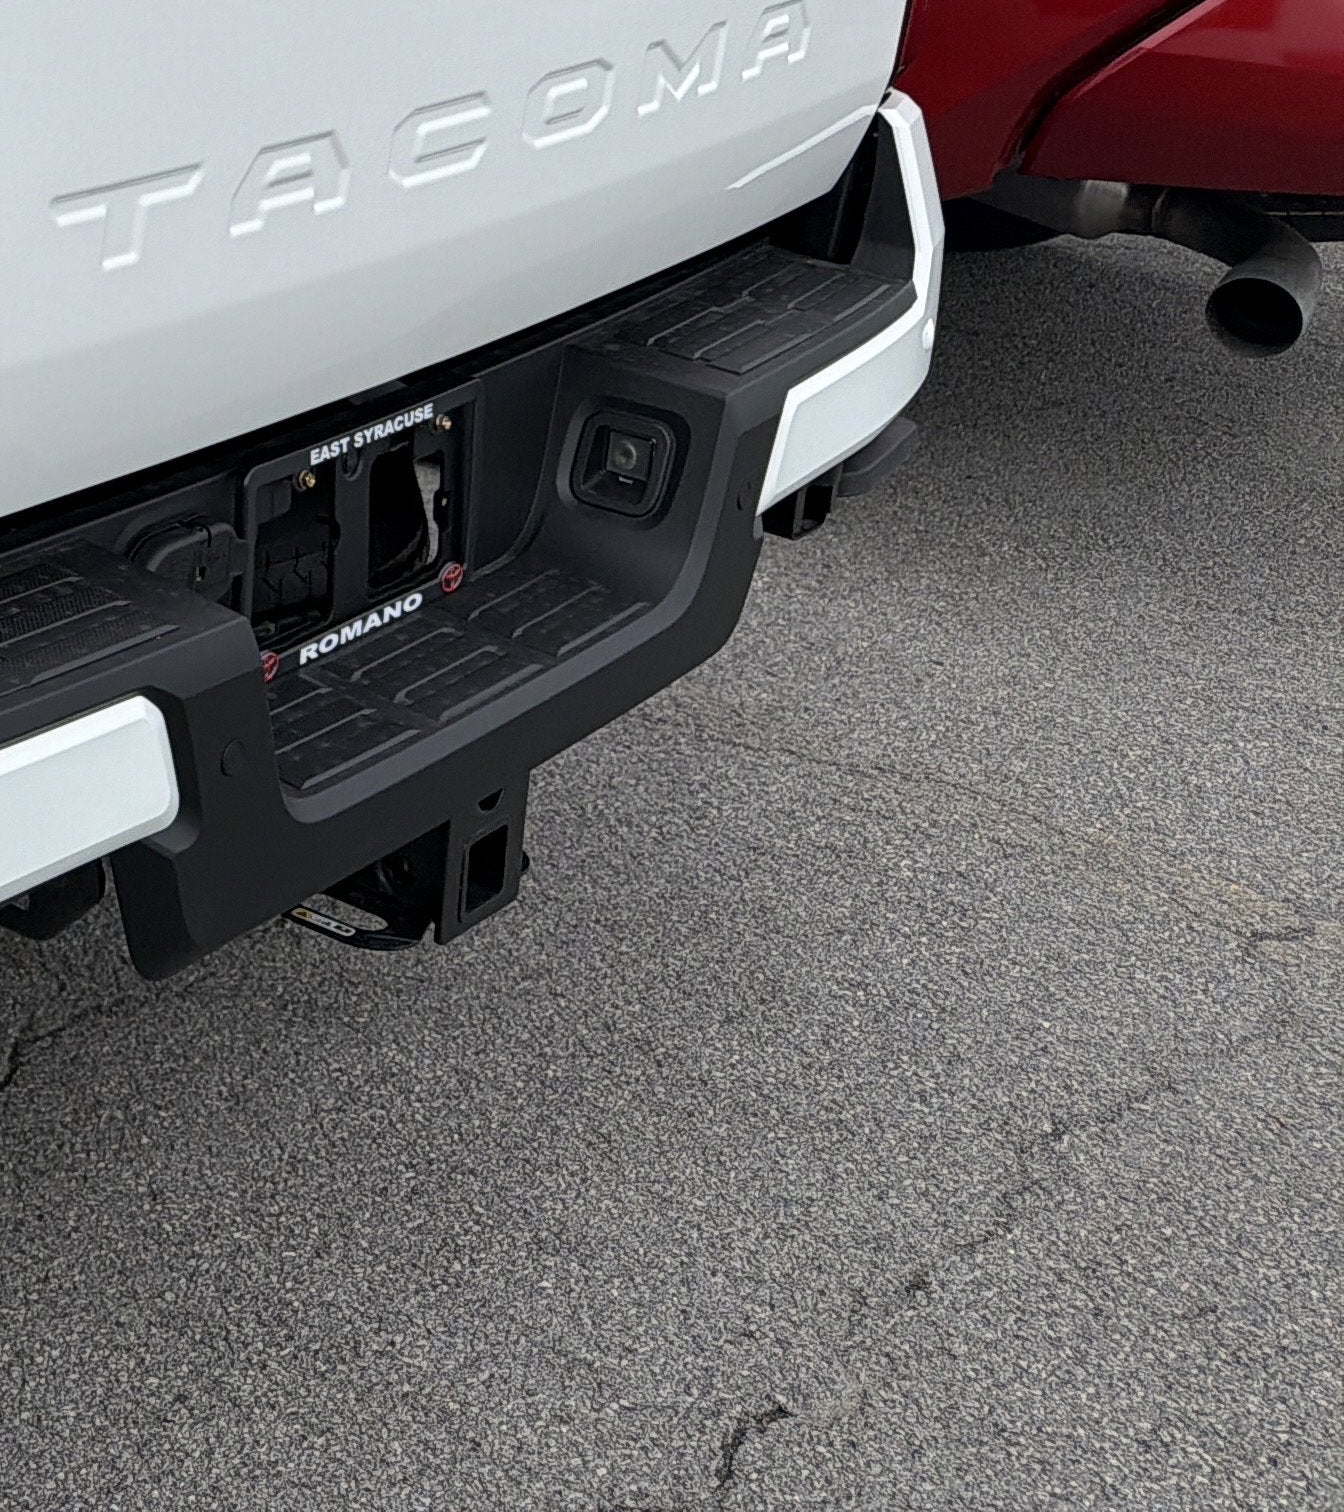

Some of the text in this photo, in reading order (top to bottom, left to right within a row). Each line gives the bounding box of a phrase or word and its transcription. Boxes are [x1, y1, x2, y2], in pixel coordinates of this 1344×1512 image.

[310, 402, 434, 466] EAST SYRACUSE
[299, 592, 423, 665] ROMANO
